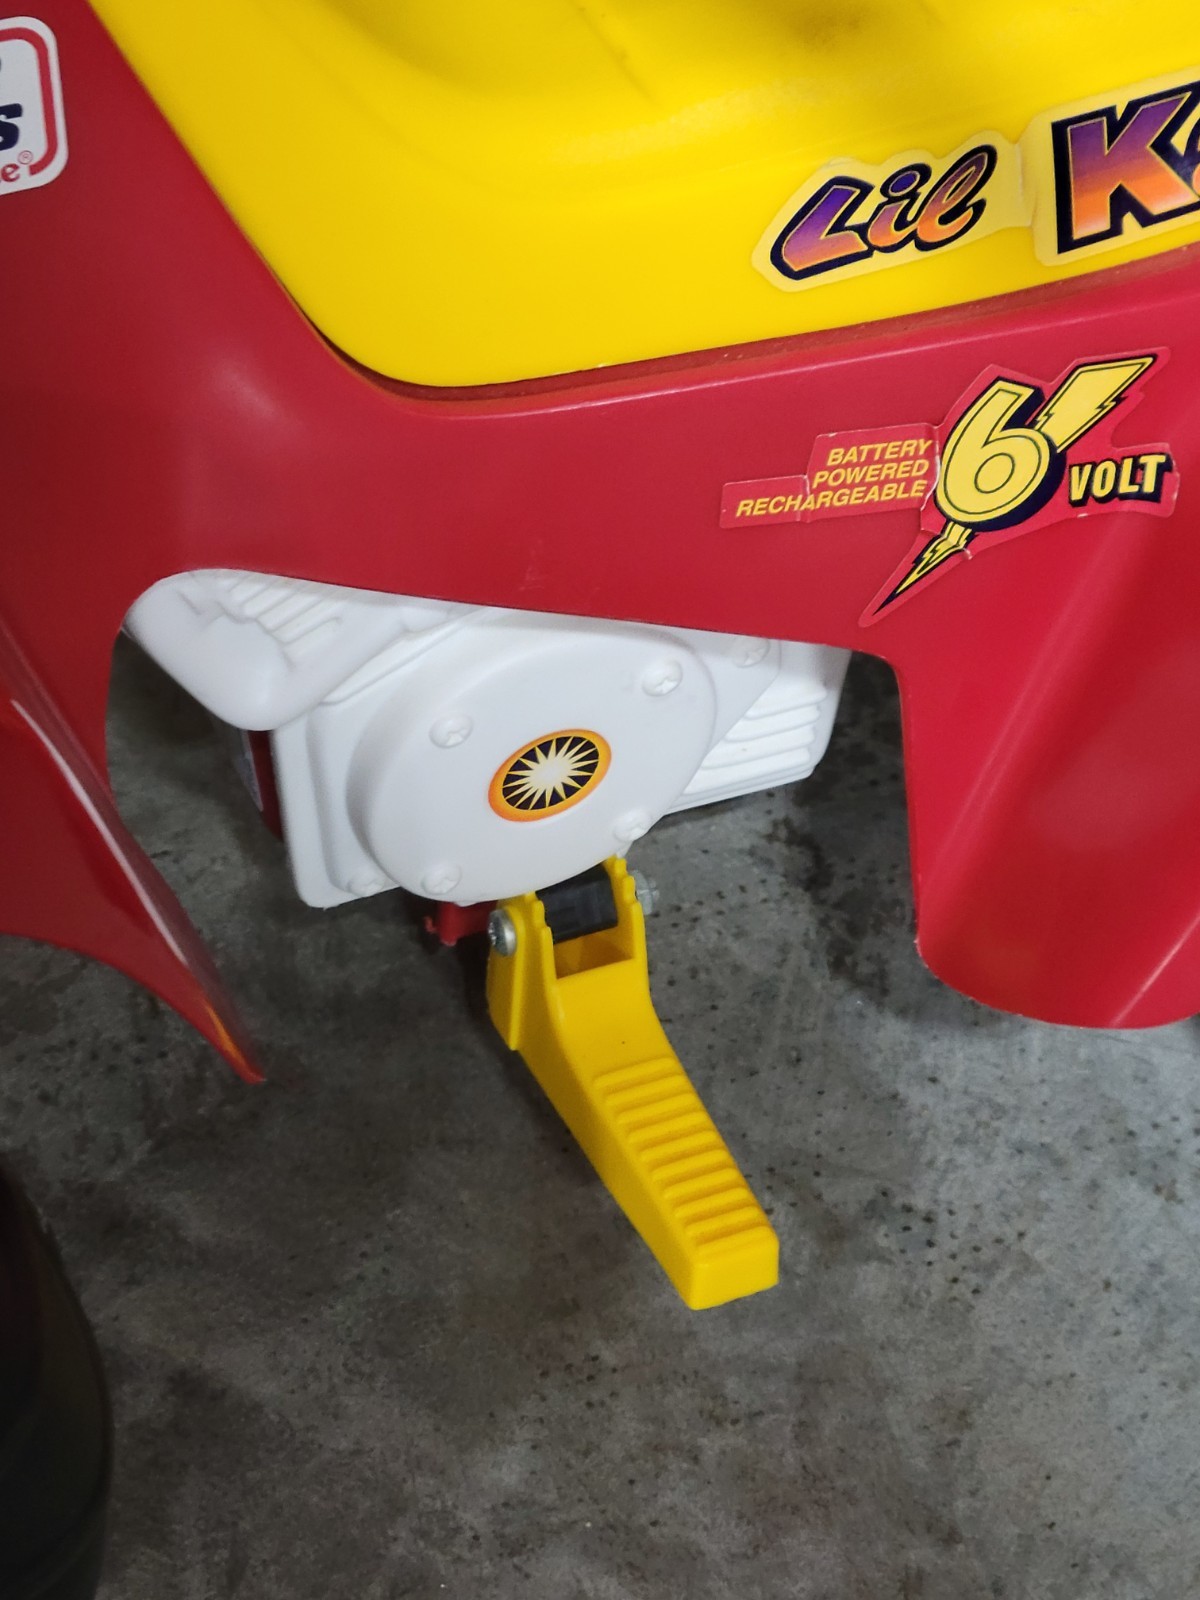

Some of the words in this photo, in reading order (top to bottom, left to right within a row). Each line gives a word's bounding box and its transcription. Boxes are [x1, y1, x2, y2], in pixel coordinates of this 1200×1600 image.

[770, 144, 998, 280] Lil
[1051, 80, 1200, 254] K
[827, 438, 932, 466] BATTERY
[936, 376, 1066, 532] 6
[1069, 452, 1173, 506] VOLT
[812, 459, 929, 488] POWERED
[736, 480, 928, 518] RECHARGEABLE
